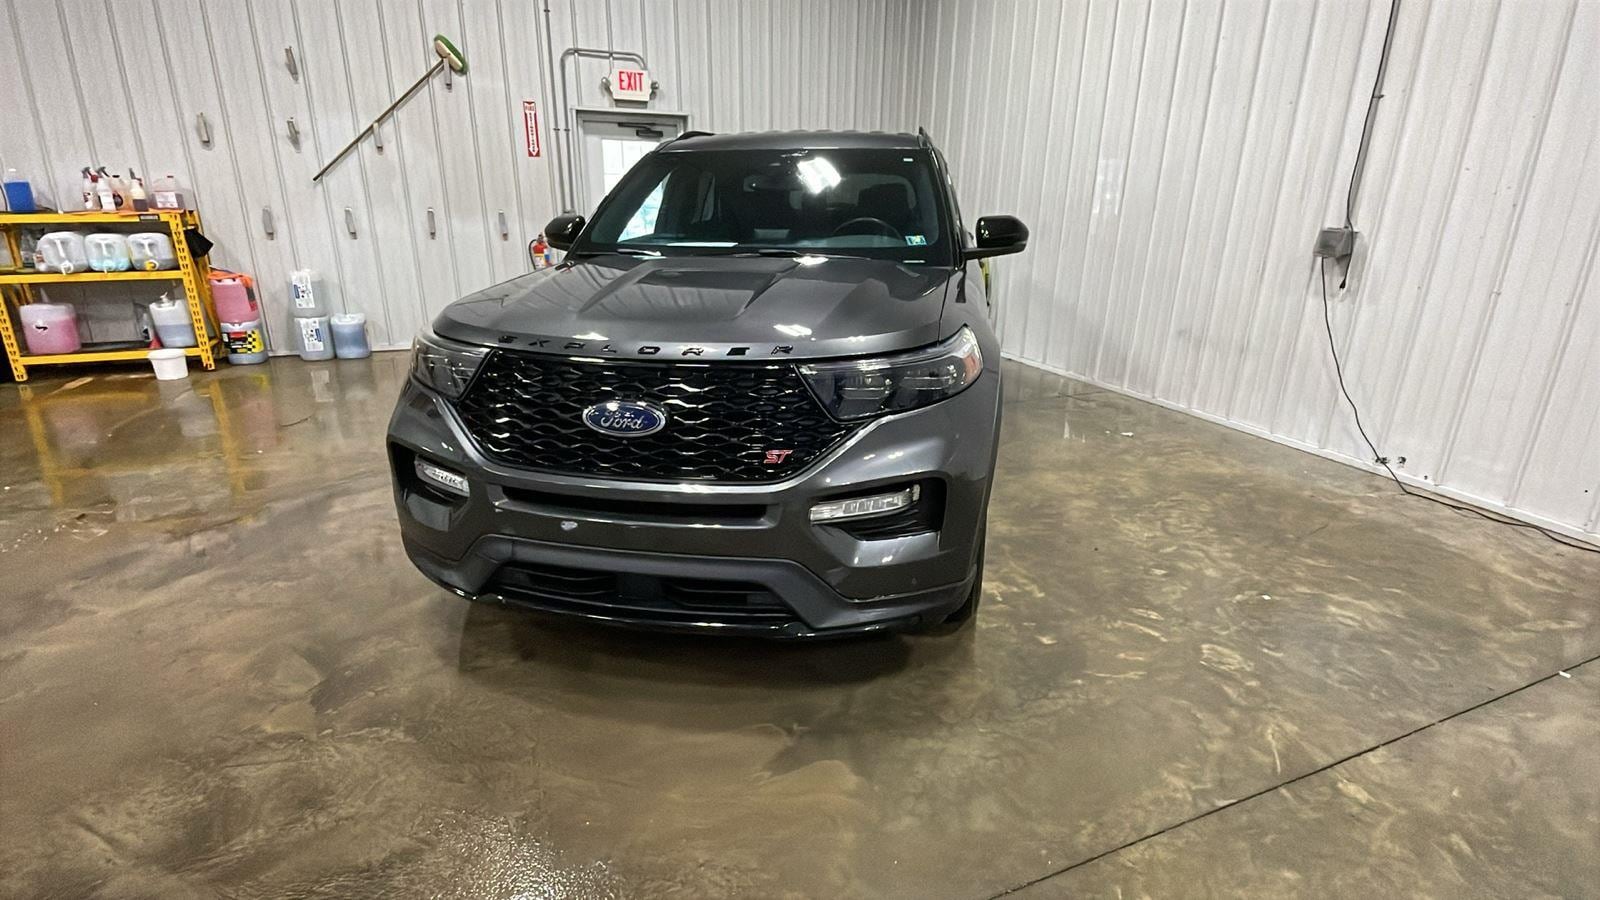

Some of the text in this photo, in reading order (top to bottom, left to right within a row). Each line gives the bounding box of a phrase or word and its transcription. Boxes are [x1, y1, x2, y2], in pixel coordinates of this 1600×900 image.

[618, 71, 644, 92] EXIT
[497, 336, 795, 357] EXPLORER
[600, 410, 645, 430] Ford
[763, 449, 793, 464] ST
